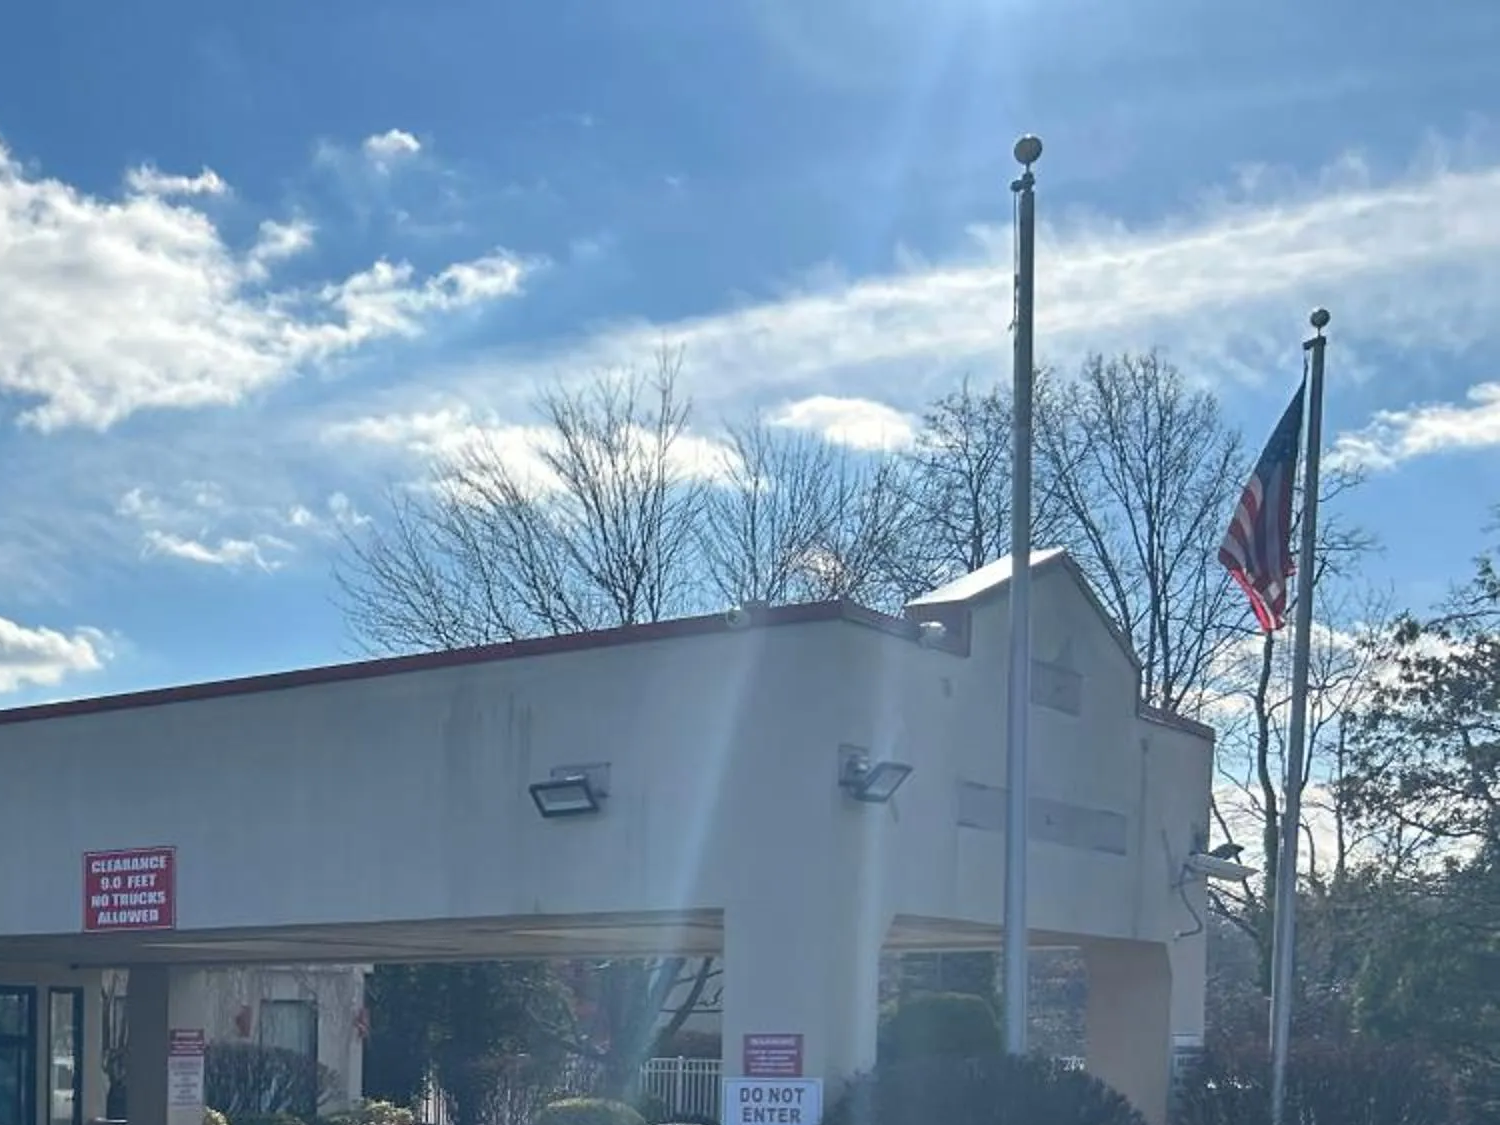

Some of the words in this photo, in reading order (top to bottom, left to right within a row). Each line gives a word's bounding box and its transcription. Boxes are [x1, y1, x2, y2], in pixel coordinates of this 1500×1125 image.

[91, 856, 166, 873] CLEARANCE
[127, 873, 156, 889] FEET
[91, 894, 109, 908] NO
[112, 891, 166, 907] TRUCKS
[97, 909, 159, 925] ALLOWED
[740, 1087, 763, 1103] DO
[767, 1087, 805, 1105] NOT
[742, 1107, 802, 1124] ENTER
